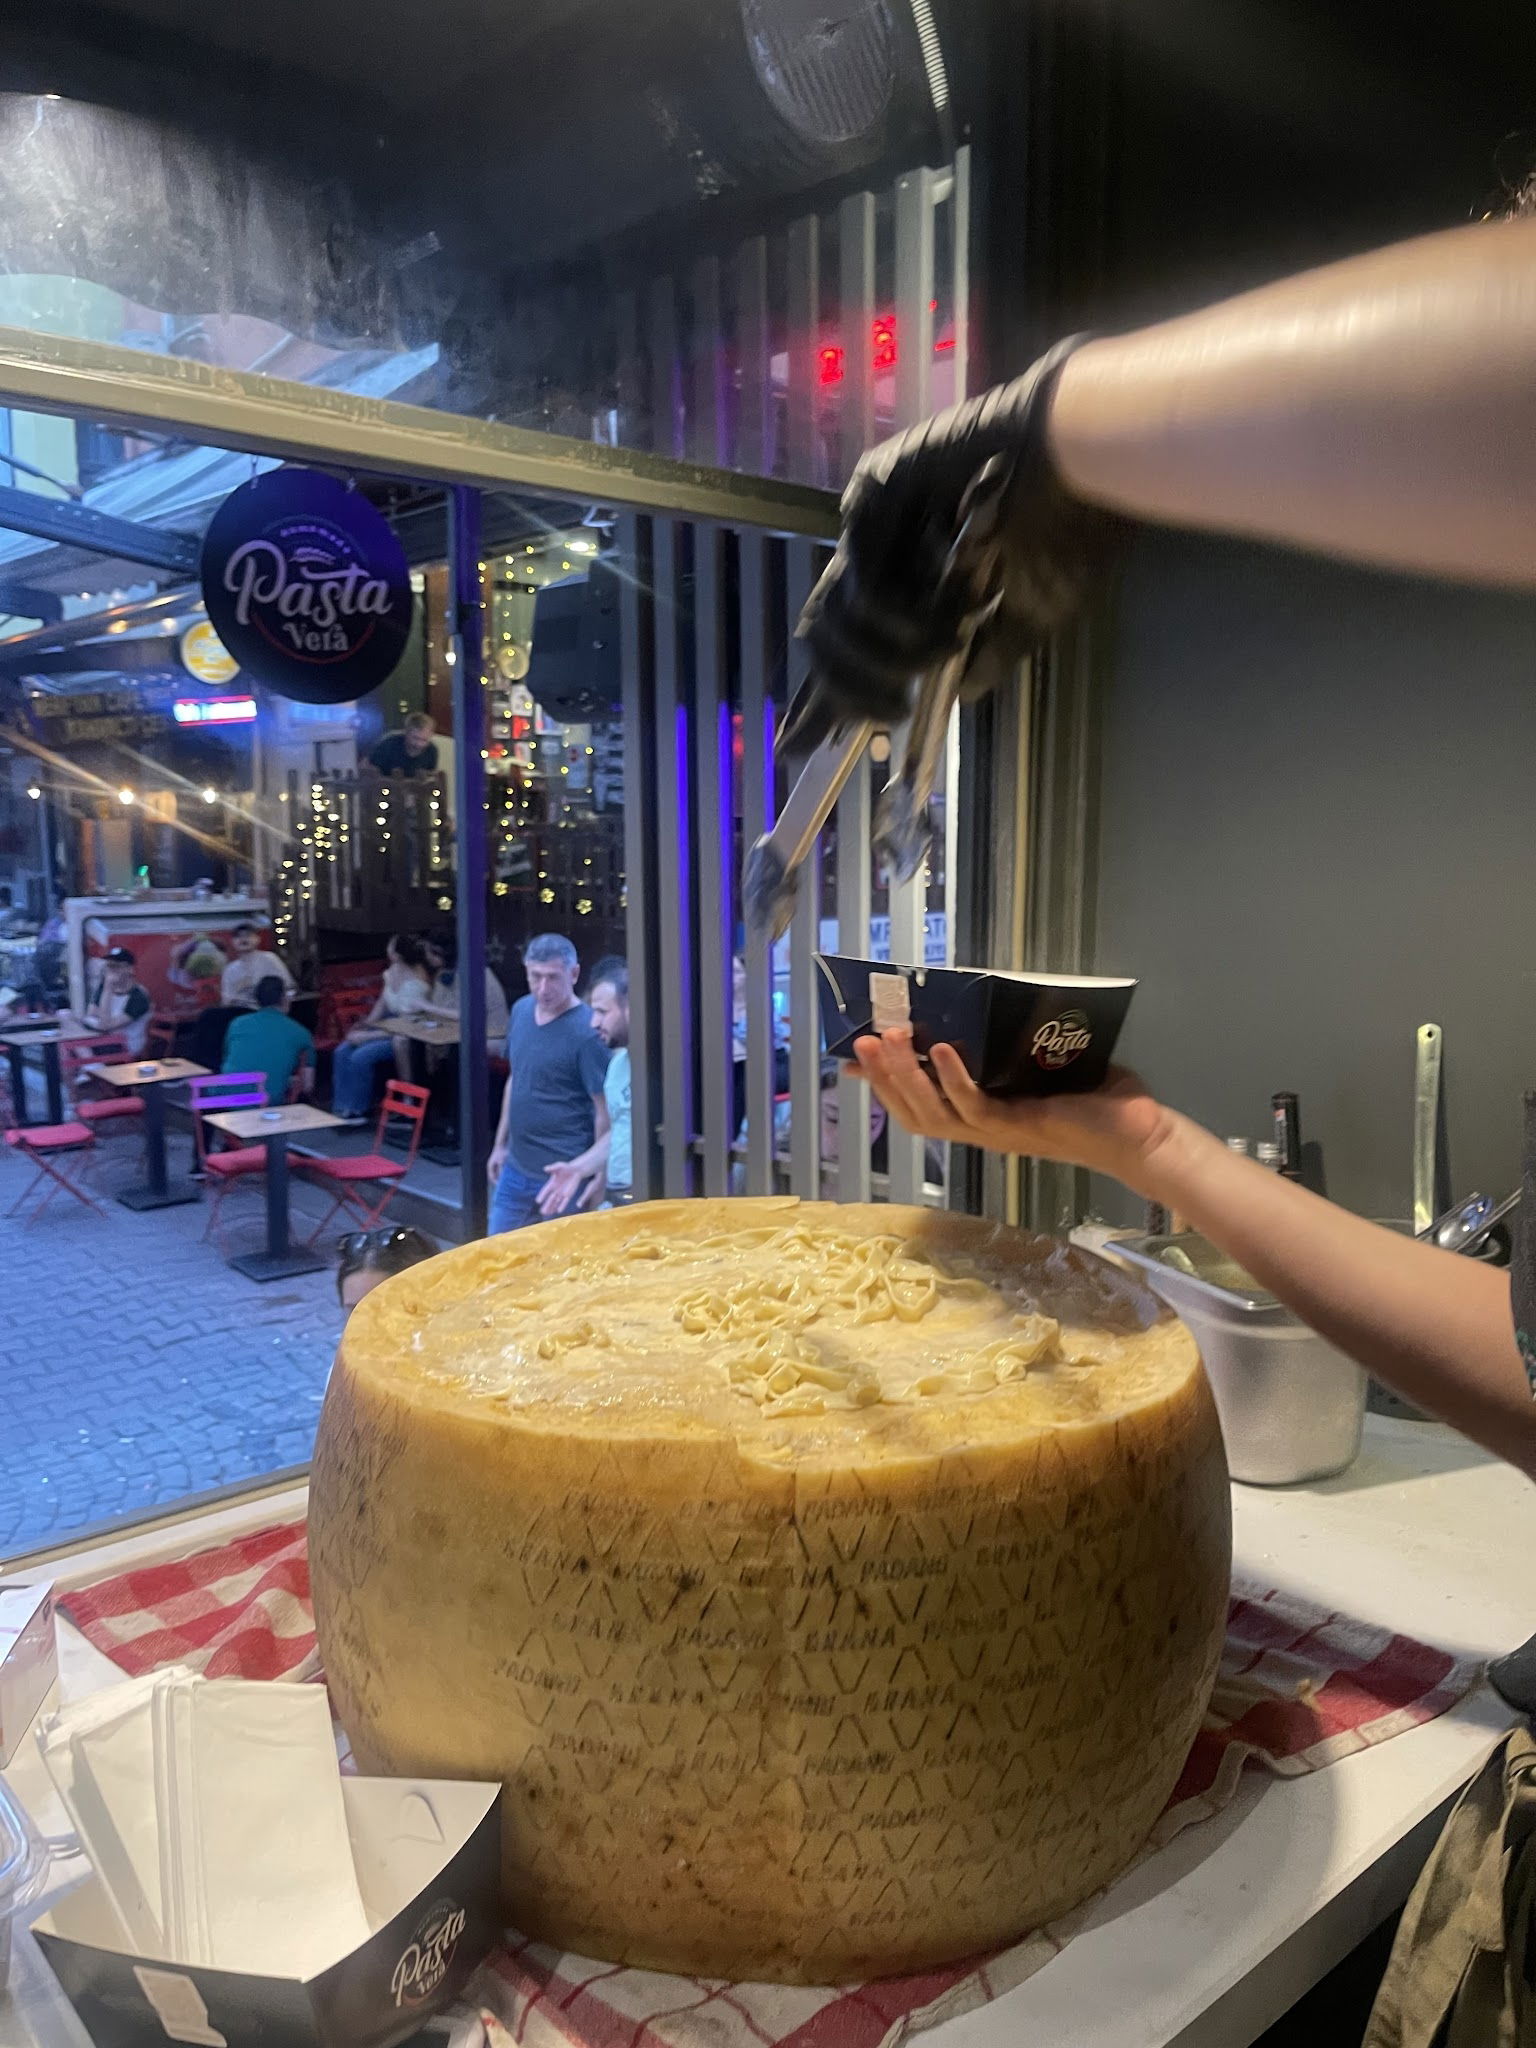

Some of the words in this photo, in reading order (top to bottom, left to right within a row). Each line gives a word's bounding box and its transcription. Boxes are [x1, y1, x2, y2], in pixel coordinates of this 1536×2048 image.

[223, 539, 394, 627] Pasta
[1030, 1021, 1093, 1056] Pasta
[390, 1908, 466, 2007] Pasta
